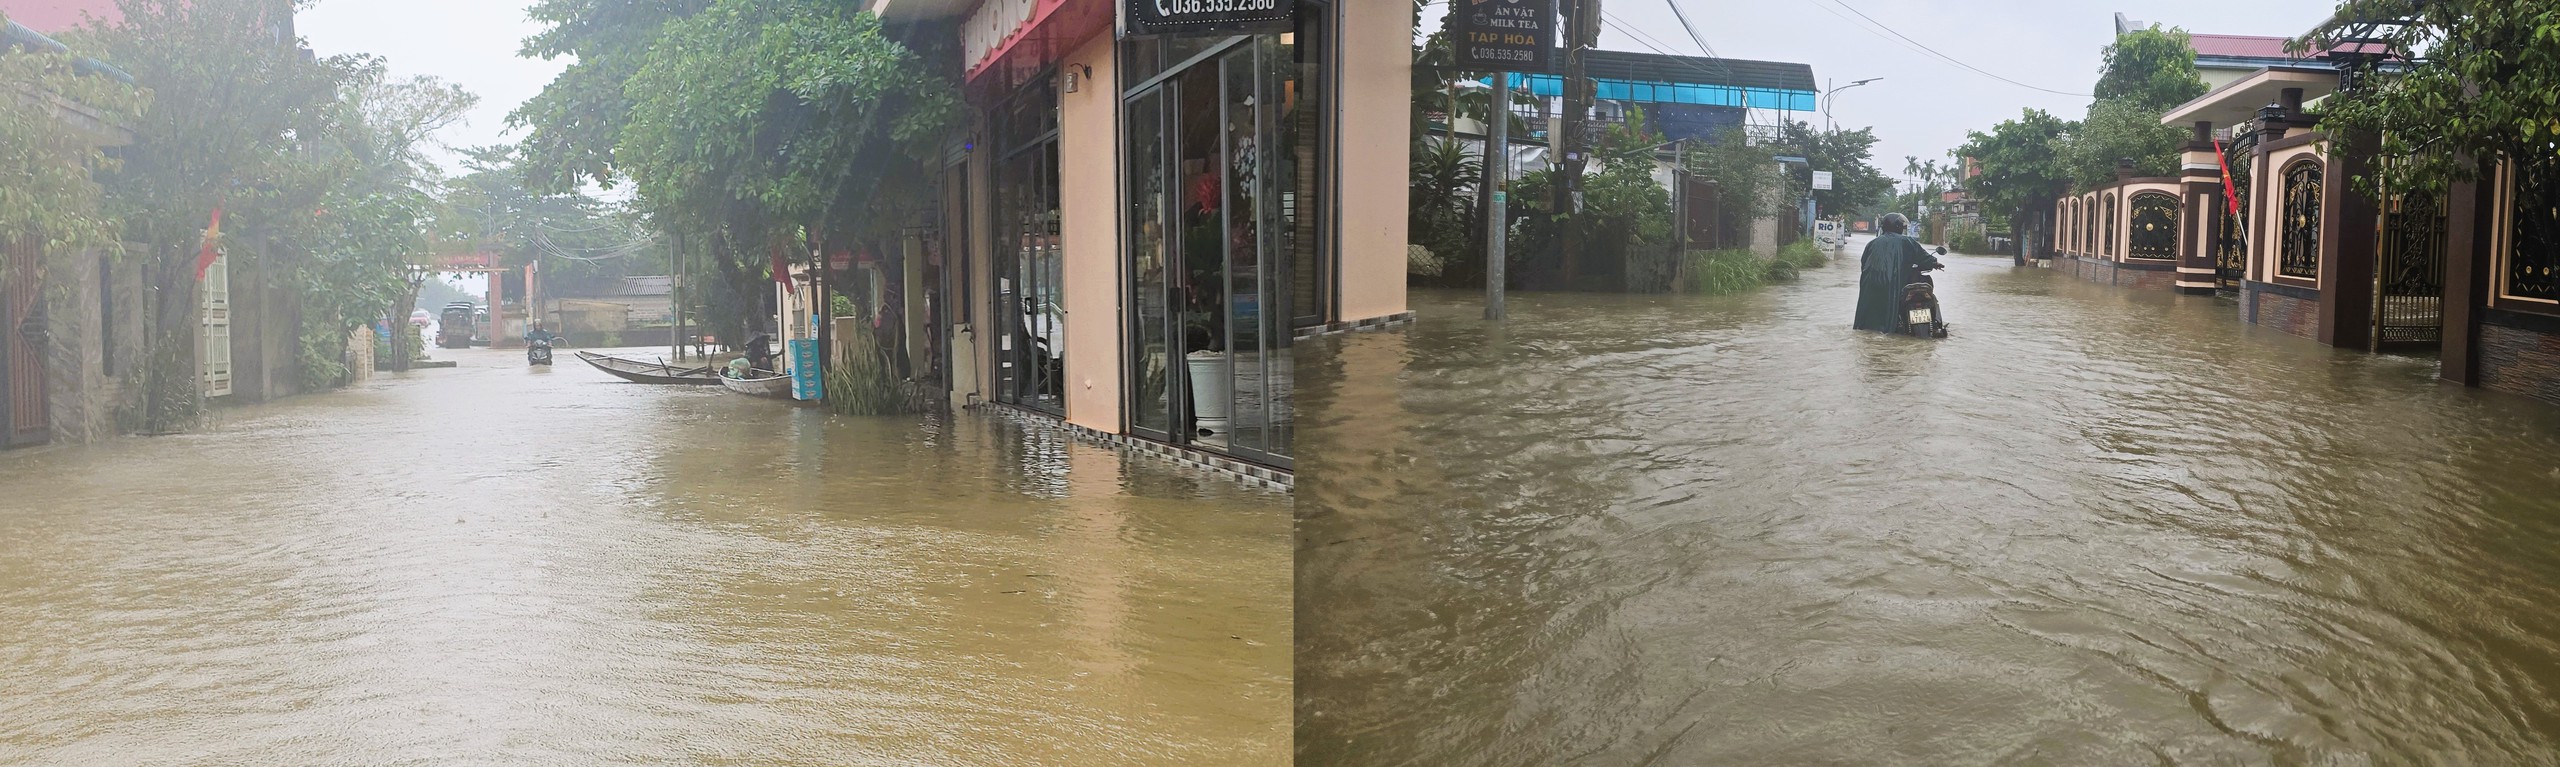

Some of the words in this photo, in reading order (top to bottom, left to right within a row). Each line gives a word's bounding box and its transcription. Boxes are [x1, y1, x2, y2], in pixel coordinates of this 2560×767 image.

[1495, 5, 1510, 16] ĂN
[1513, 6, 1535, 19] VẬT
[1490, 18, 1515, 28] MILK
[1518, 20, 1539, 30] TEA
[1480, 47, 1534, 62] 036.535.2580
